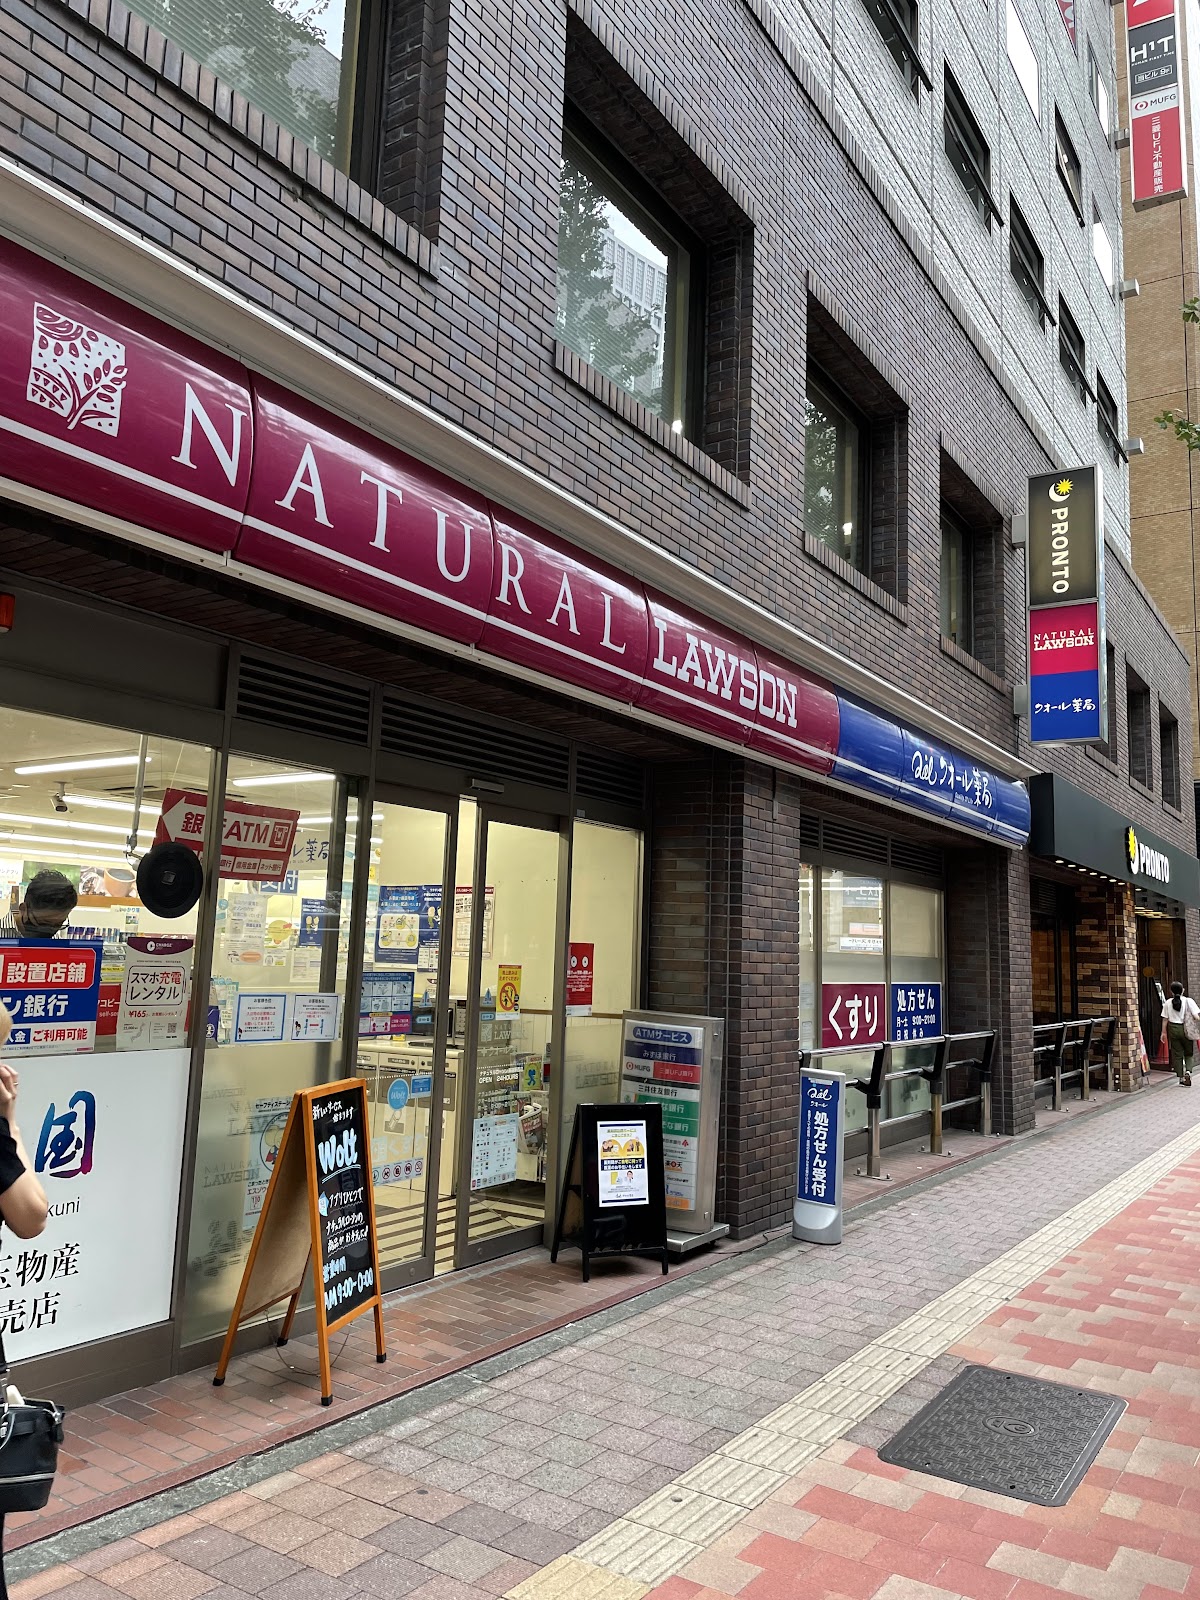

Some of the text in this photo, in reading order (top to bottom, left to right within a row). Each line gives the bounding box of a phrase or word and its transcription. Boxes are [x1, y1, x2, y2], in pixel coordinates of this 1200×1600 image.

[1150, 93, 1177, 107] MUFG
[171, 382, 798, 729] NATURAL LAWSON
[1051, 506, 1070, 594] PRONTO
[1033, 627, 1095, 641] NATURAL
[1033, 635, 1095, 652] LAWSON
[1034, 698, 1096, 714] クオール薬局
[939, 755, 993, 809] クオール薬局
[235, 861, 258, 870] 信用金庫
[260, 863, 282, 872] ネット銀行
[1139, 842, 1170, 884] PRONTO
[6, 962, 87, 984] 設置店舗
[131, 971, 182, 986] スマホ充電
[130, 986, 180, 1001] レンタル
[827, 988, 935, 1041] くすり 処方せん
[32, 1028, 88, 1043] ご利用可能
[635, 1028, 689, 1043] ATMサービス
[642, 1050, 677, 1061] みずほ銀行
[634, 1064, 651, 1072] MUFG
[659, 1067, 694, 1078] 三菱UFJ銀行
[478, 1073, 519, 1084] OPEN 24HOURS
[637, 1084, 678, 1097] 三井住友銀行
[317, 1127, 358, 1175] Wolt
[811, 1111, 830, 1198] 処方せん受付
[202, 1167, 260, 1188] LAWSON
